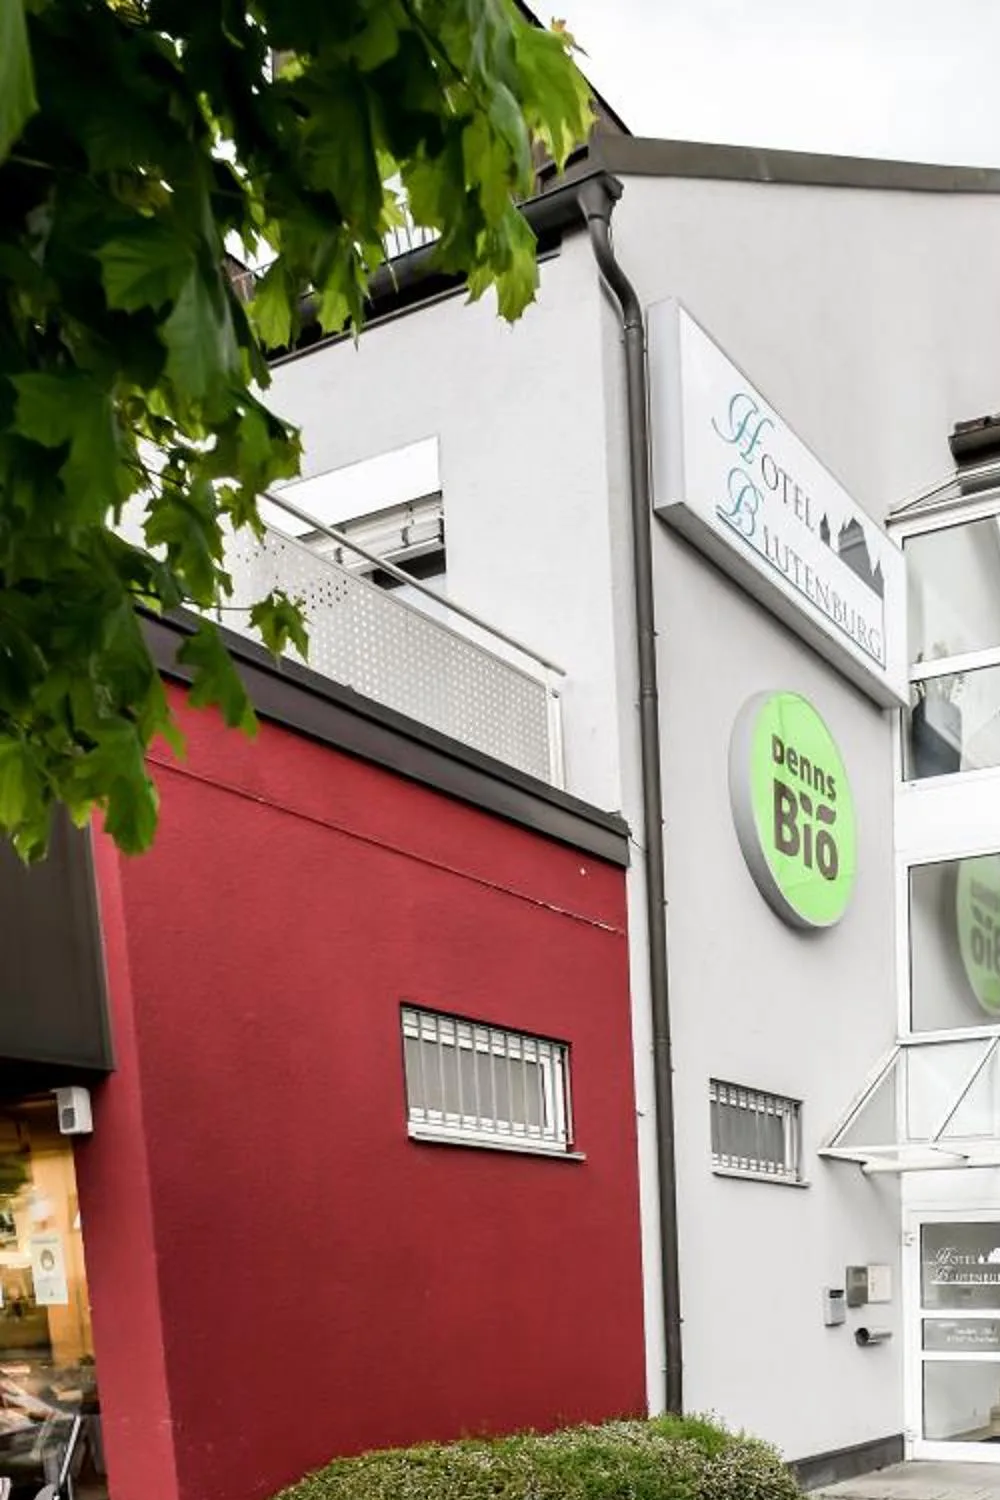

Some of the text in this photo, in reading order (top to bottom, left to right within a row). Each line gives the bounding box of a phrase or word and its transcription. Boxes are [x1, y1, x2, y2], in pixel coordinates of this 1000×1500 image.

[711, 393, 815, 533] HOTEL
[715, 467, 882, 660] BLUTENBURG
[772, 733, 837, 801] Denns
[934, 1247, 976, 1265] HOTEL
